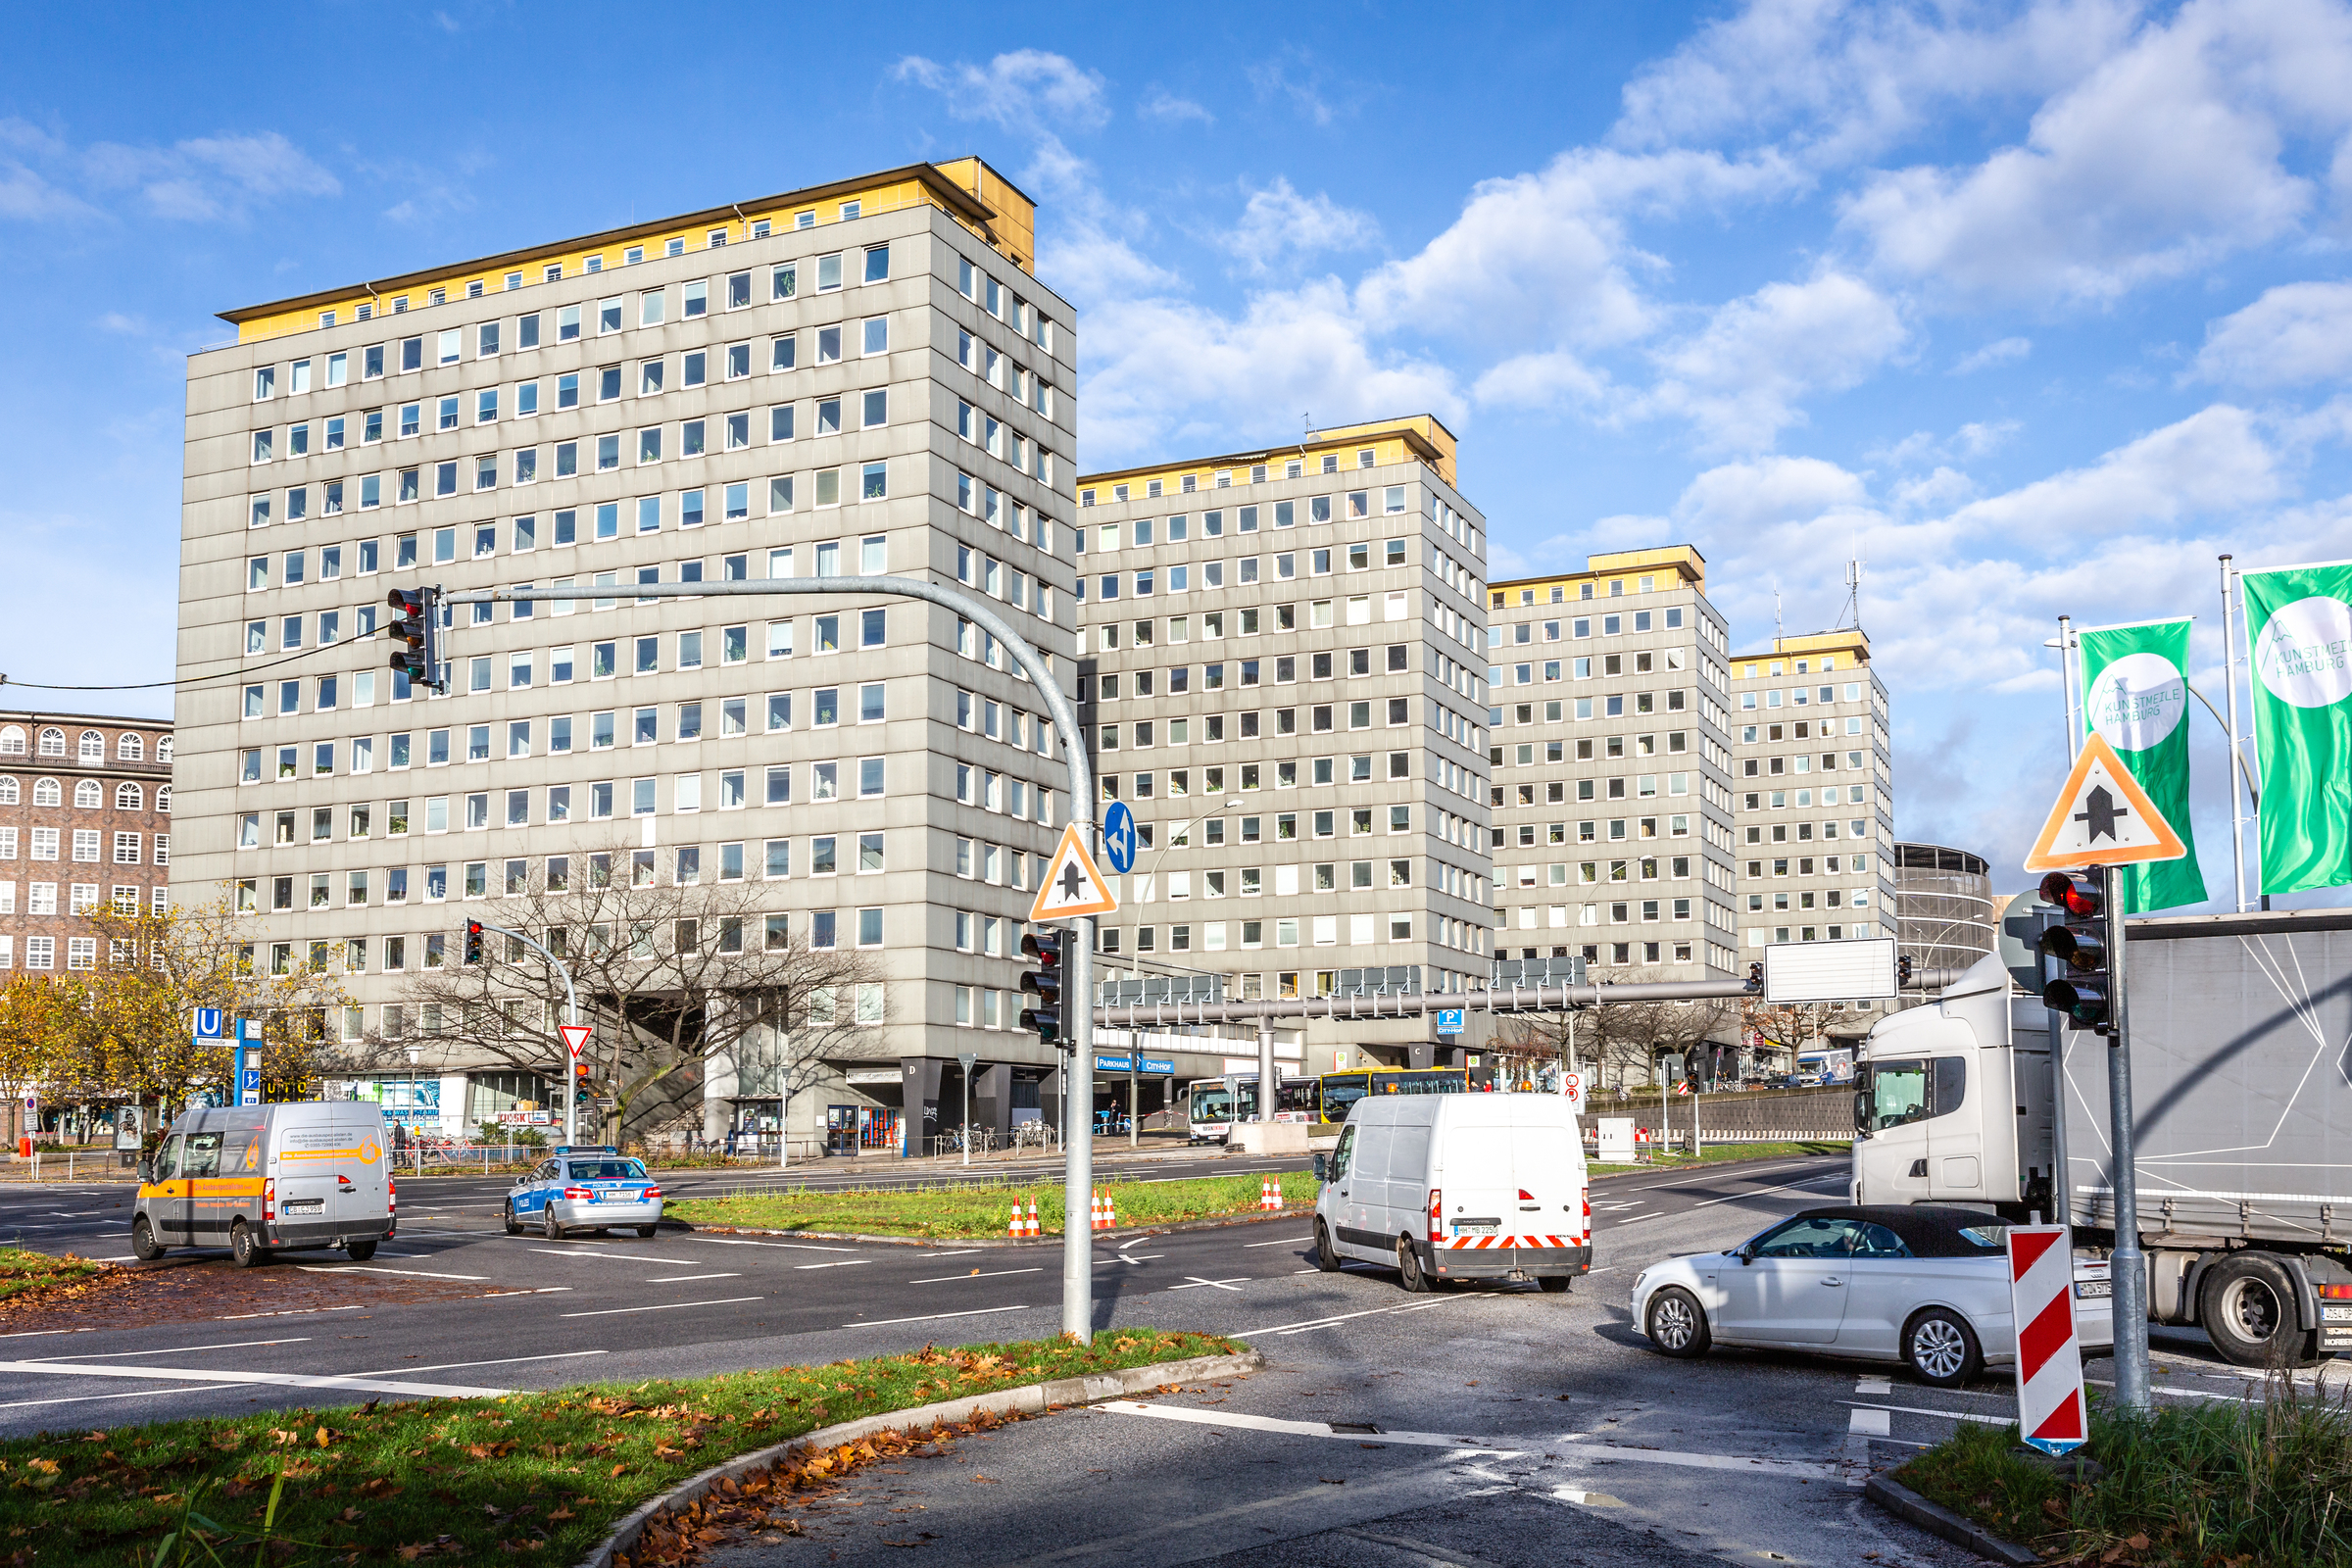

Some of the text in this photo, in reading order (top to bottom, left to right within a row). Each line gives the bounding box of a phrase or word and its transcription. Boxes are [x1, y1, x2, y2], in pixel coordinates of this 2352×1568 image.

[2277, 656, 2345, 678] HAMBURG
[2105, 689, 2180, 712] KUNSTMEILE
[2105, 705, 2161, 725] HAMBURG
[201, 1009, 219, 1035] U
[1446, 1011, 1455, 1022] P
[908, 1065, 916, 1075] D
[1099, 1058, 1172, 1071] PARKHAUS CITY-HOF
[518, 1199, 530, 1208] POLIZEI
